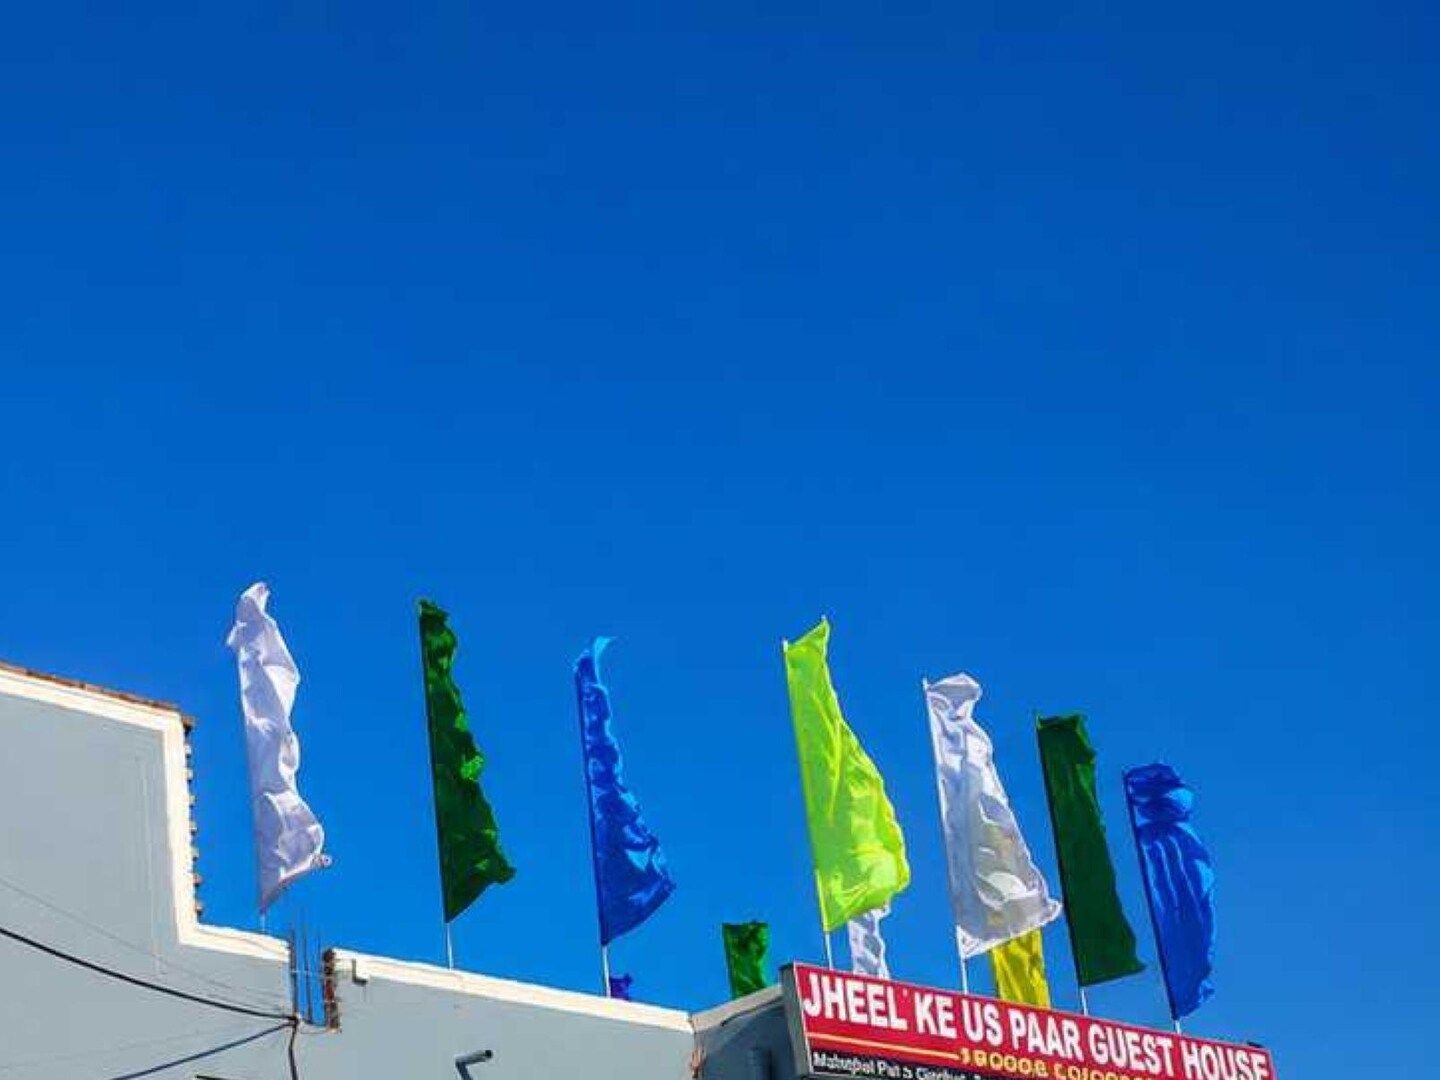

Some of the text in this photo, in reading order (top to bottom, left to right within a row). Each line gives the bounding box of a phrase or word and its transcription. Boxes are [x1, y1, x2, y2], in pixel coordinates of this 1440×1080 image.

[802, 973, 908, 1030] JHEEL
[913, 991, 959, 1039] KE
[962, 999, 1003, 1047] US
[1008, 1008, 1085, 1062] PAAR
[1088, 1022, 1176, 1077] GUEST
